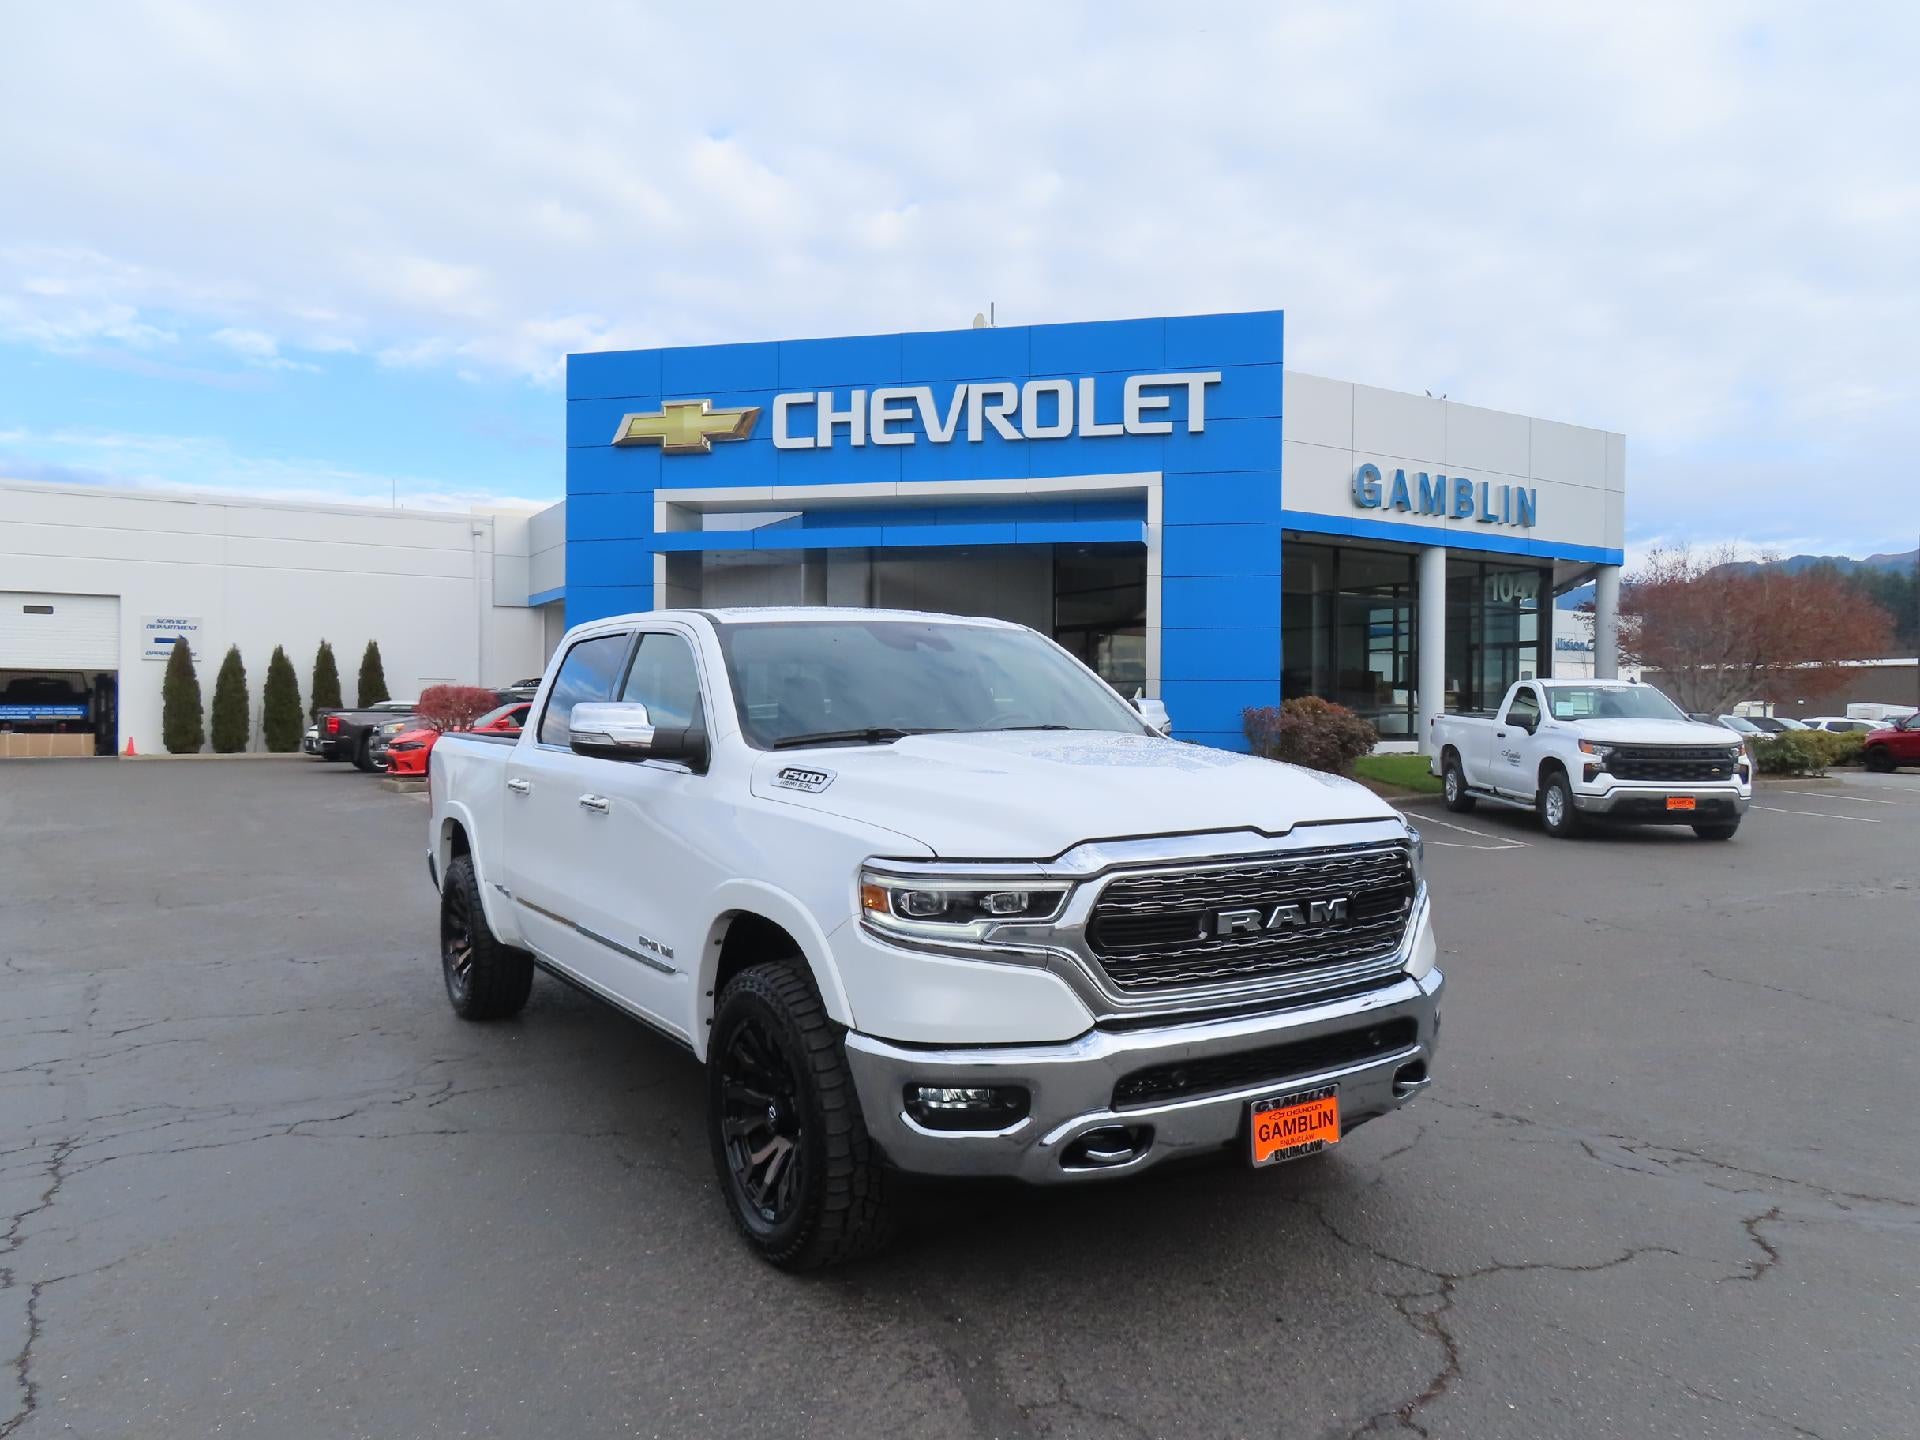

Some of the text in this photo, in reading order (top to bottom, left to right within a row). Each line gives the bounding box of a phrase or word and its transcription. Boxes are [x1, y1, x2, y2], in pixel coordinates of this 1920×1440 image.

[772, 371, 1222, 449] CHEVROLET
[1352, 463, 1537, 528] GAMBLIN
[783, 770, 824, 783] 1500
[1217, 898, 1348, 935] RAM
[638, 935, 674, 958] RAM
[1255, 1086, 1336, 1113] GAMBLIN
[1258, 1109, 1334, 1143] GAMBLIN
